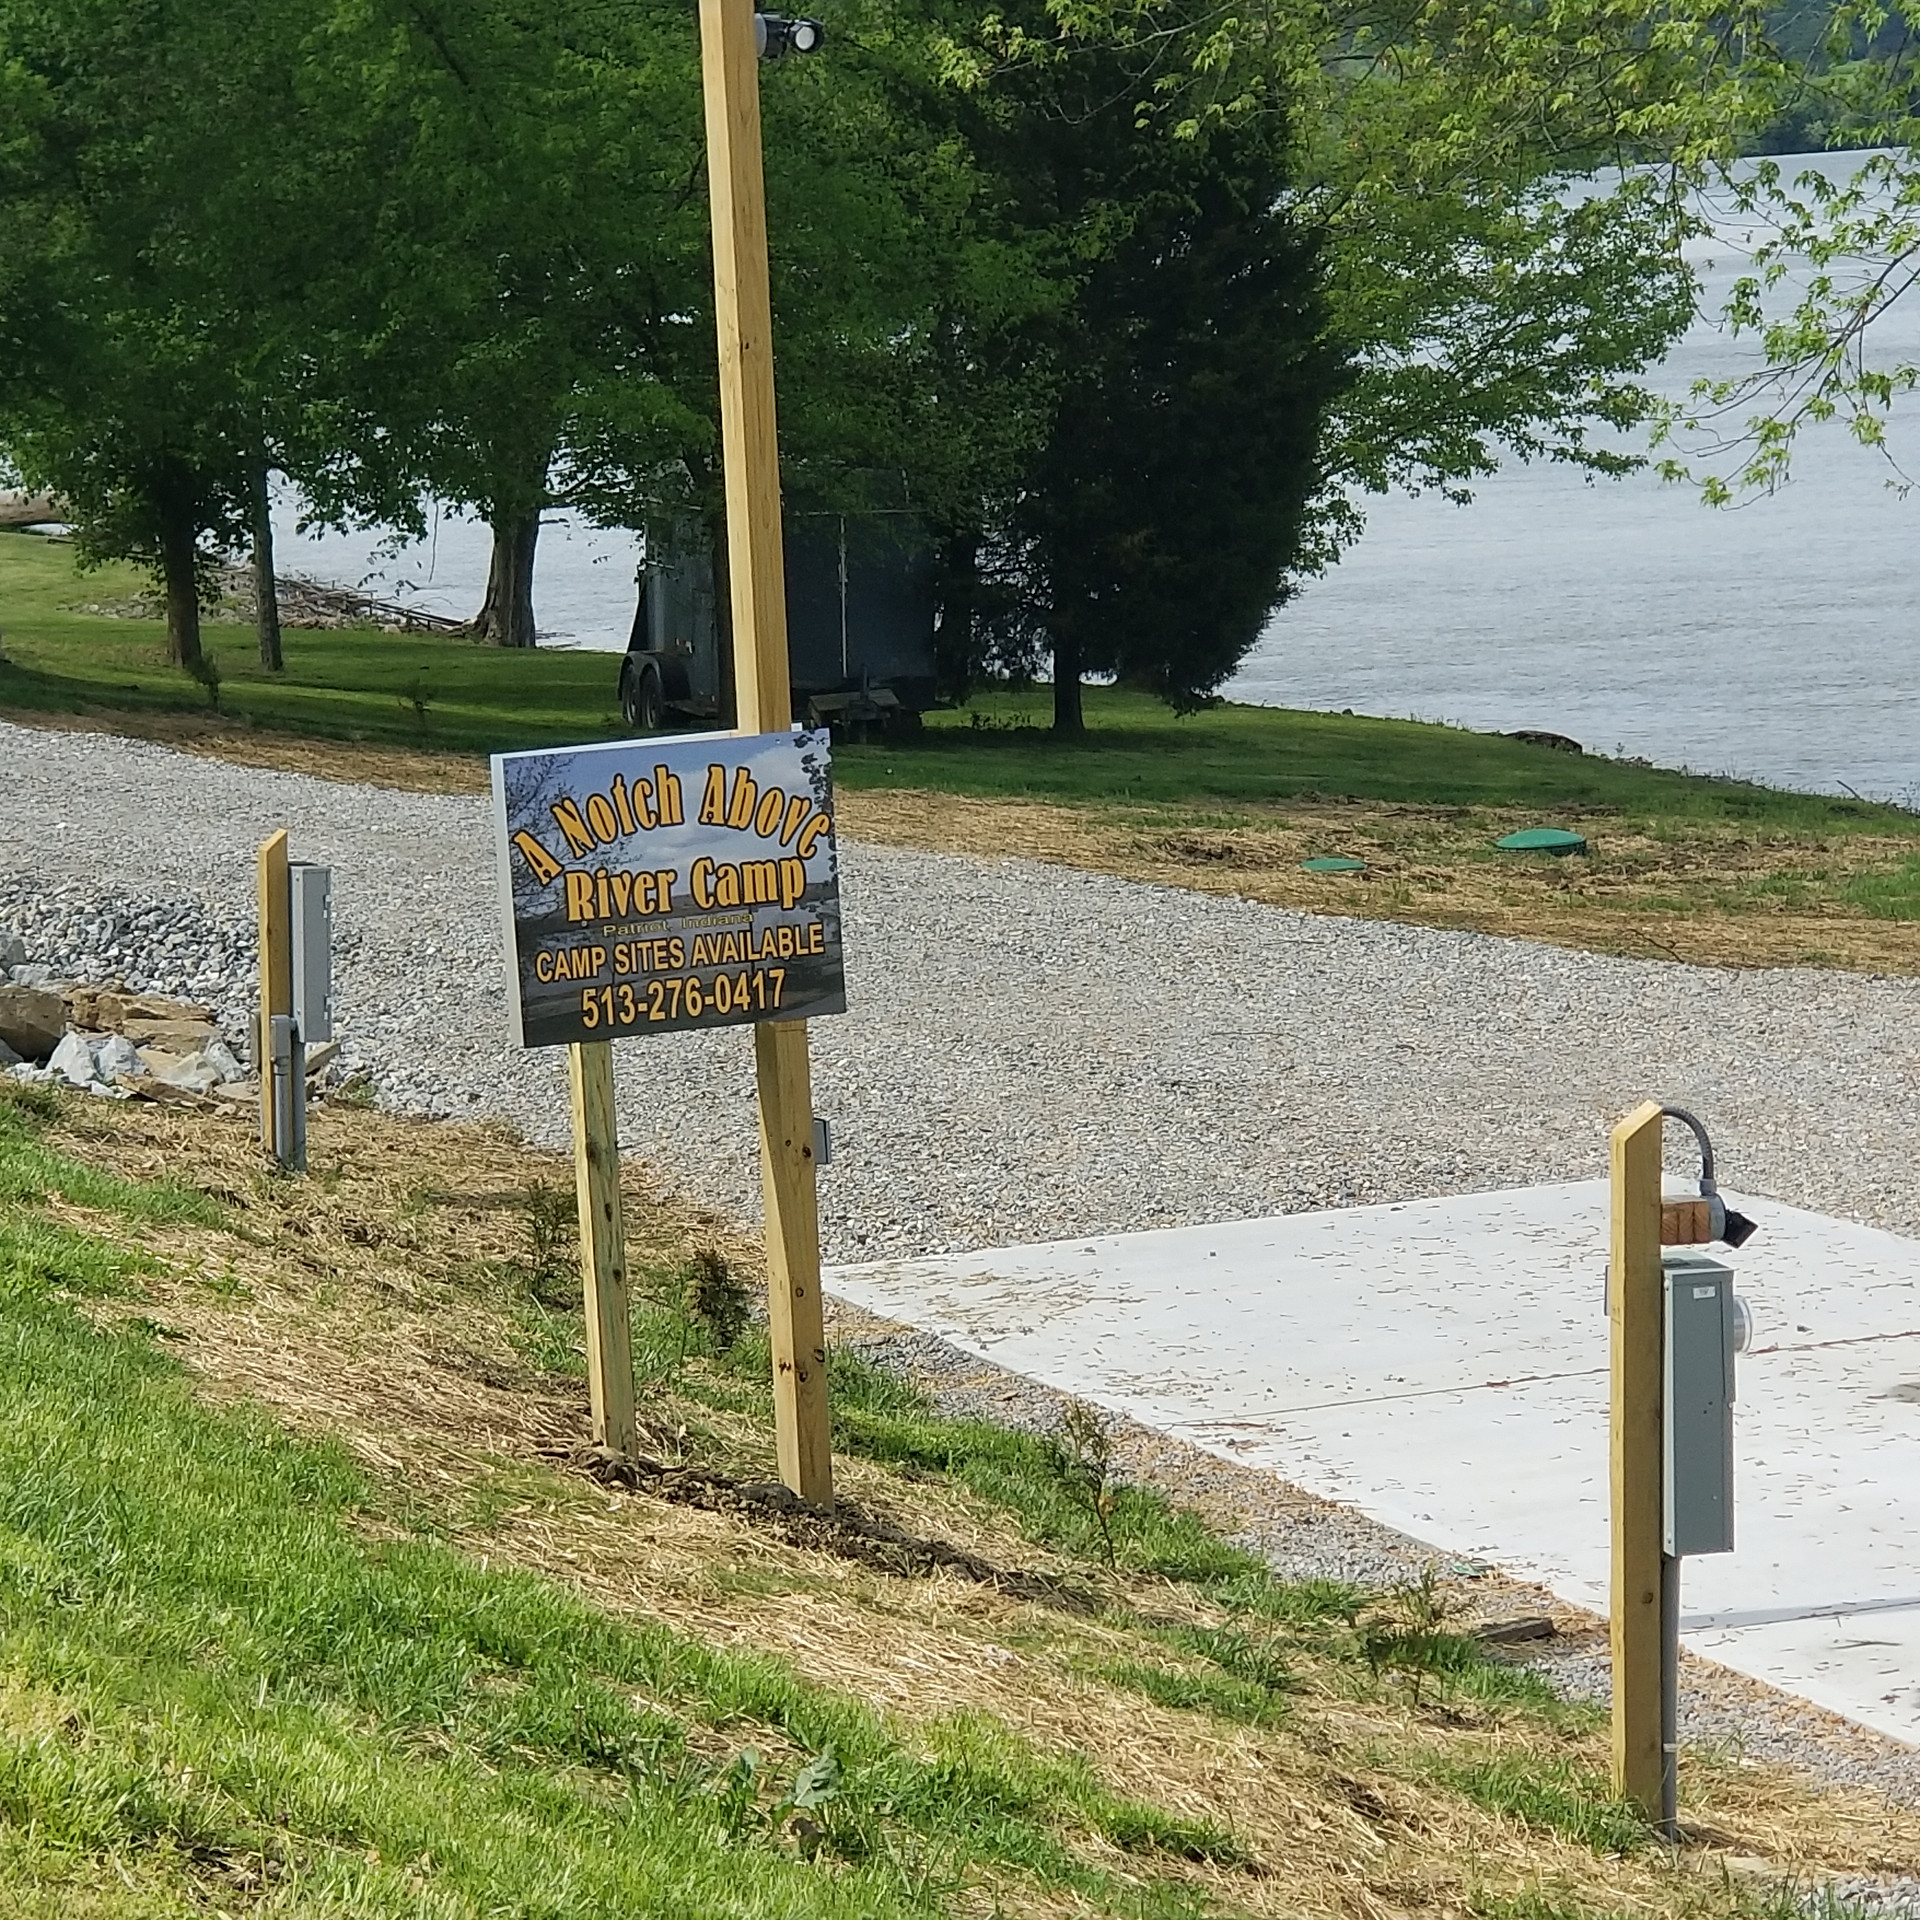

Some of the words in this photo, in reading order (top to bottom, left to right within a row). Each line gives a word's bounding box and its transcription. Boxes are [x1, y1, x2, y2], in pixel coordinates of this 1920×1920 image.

[513, 830, 564, 886] A
[552, 764, 683, 859] Notch
[699, 764, 831, 859] Above
[565, 869, 677, 922] River
[690, 857, 808, 909] Camp
[681, 912, 754, 929] Indiana
[535, 946, 605, 983] CAMP
[614, 937, 685, 974] SITES
[691, 923, 825, 967] AVAILABLE
[581, 968, 786, 1028] 513-276-0417
